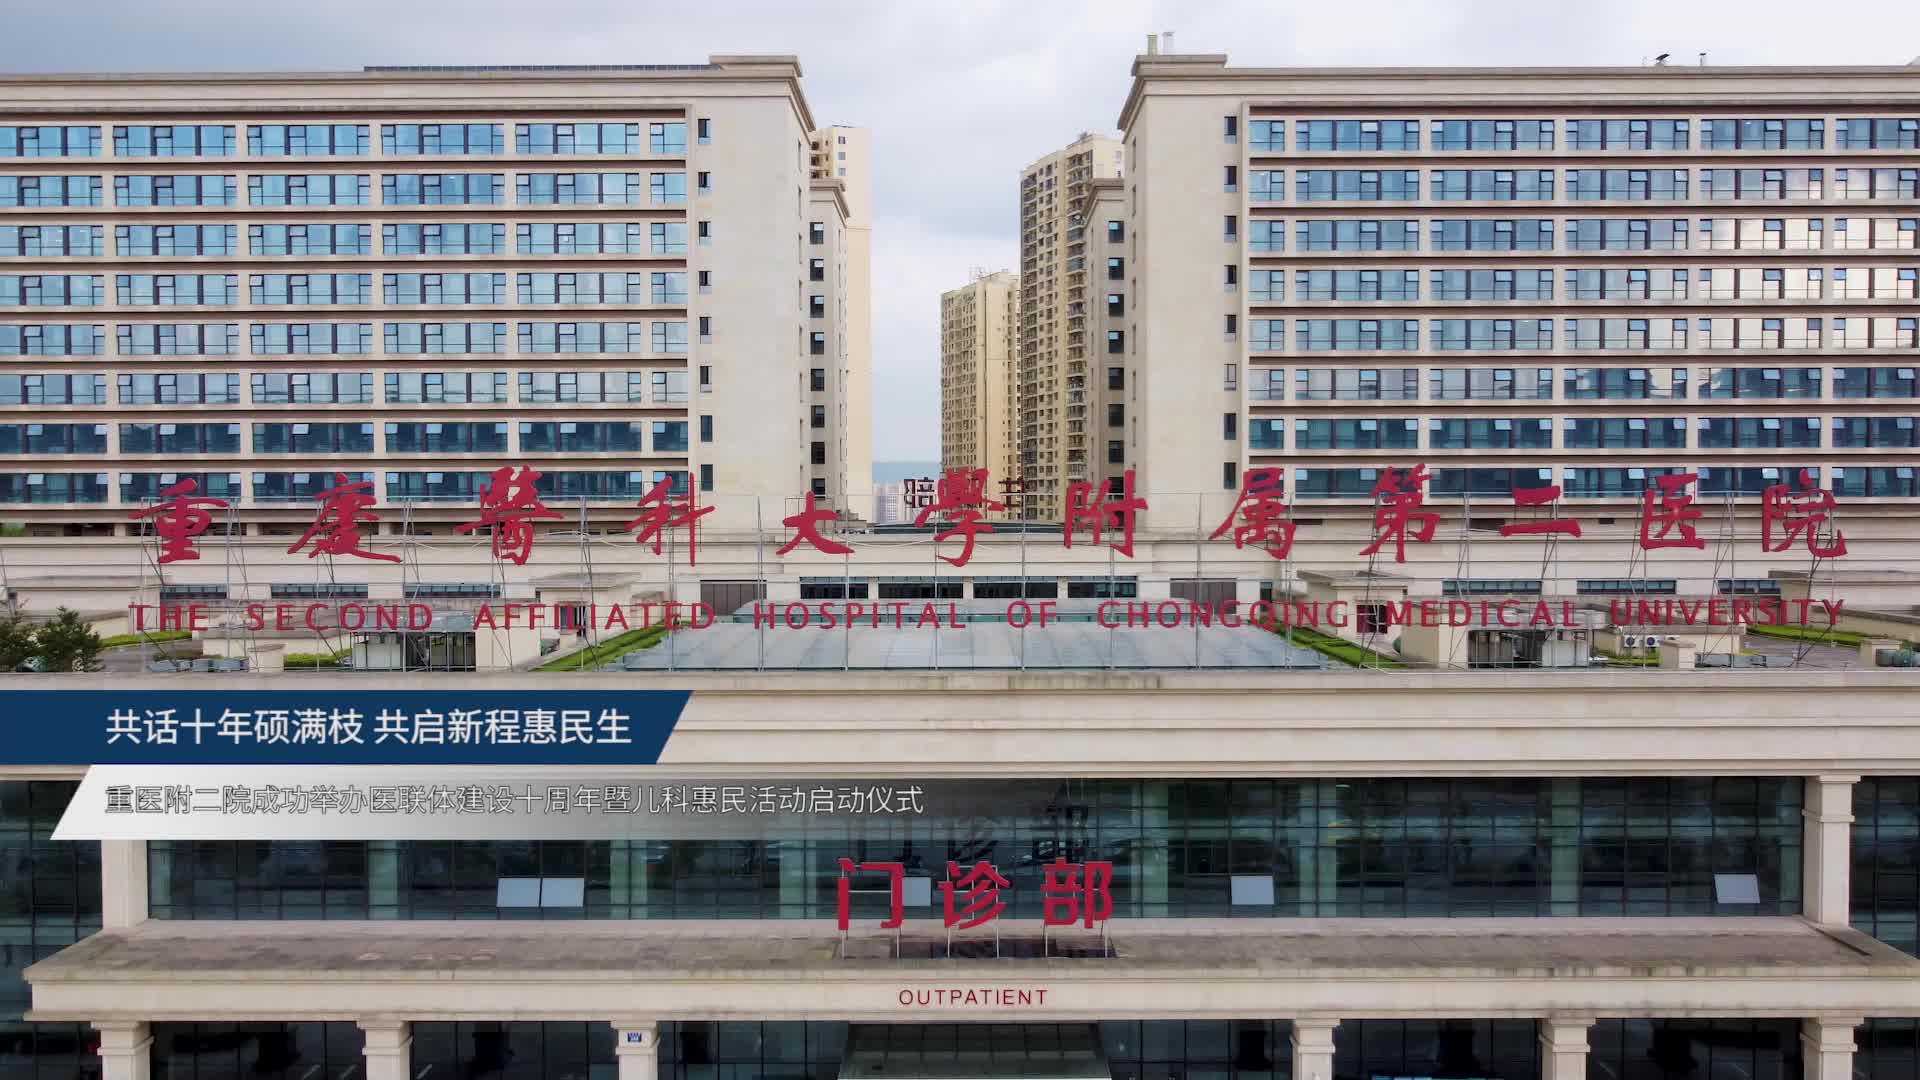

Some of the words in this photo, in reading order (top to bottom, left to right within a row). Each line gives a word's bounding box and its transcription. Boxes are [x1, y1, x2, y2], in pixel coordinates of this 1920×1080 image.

[129, 604, 208, 631] THE
[247, 603, 433, 631] SECOND
[474, 602, 714, 631] AFFILIATED
[754, 602, 964, 629] HOSPITAL
[1008, 601, 1056, 628] OF
[1098, 600, 1349, 631] CHONGQING
[1386, 600, 1577, 628] MEDICAL
[1611, 598, 1842, 626] UNIVERSITY
[837, 857, 1112, 931] 门诊部
[898, 988, 1048, 1006] OUTPATIENT
